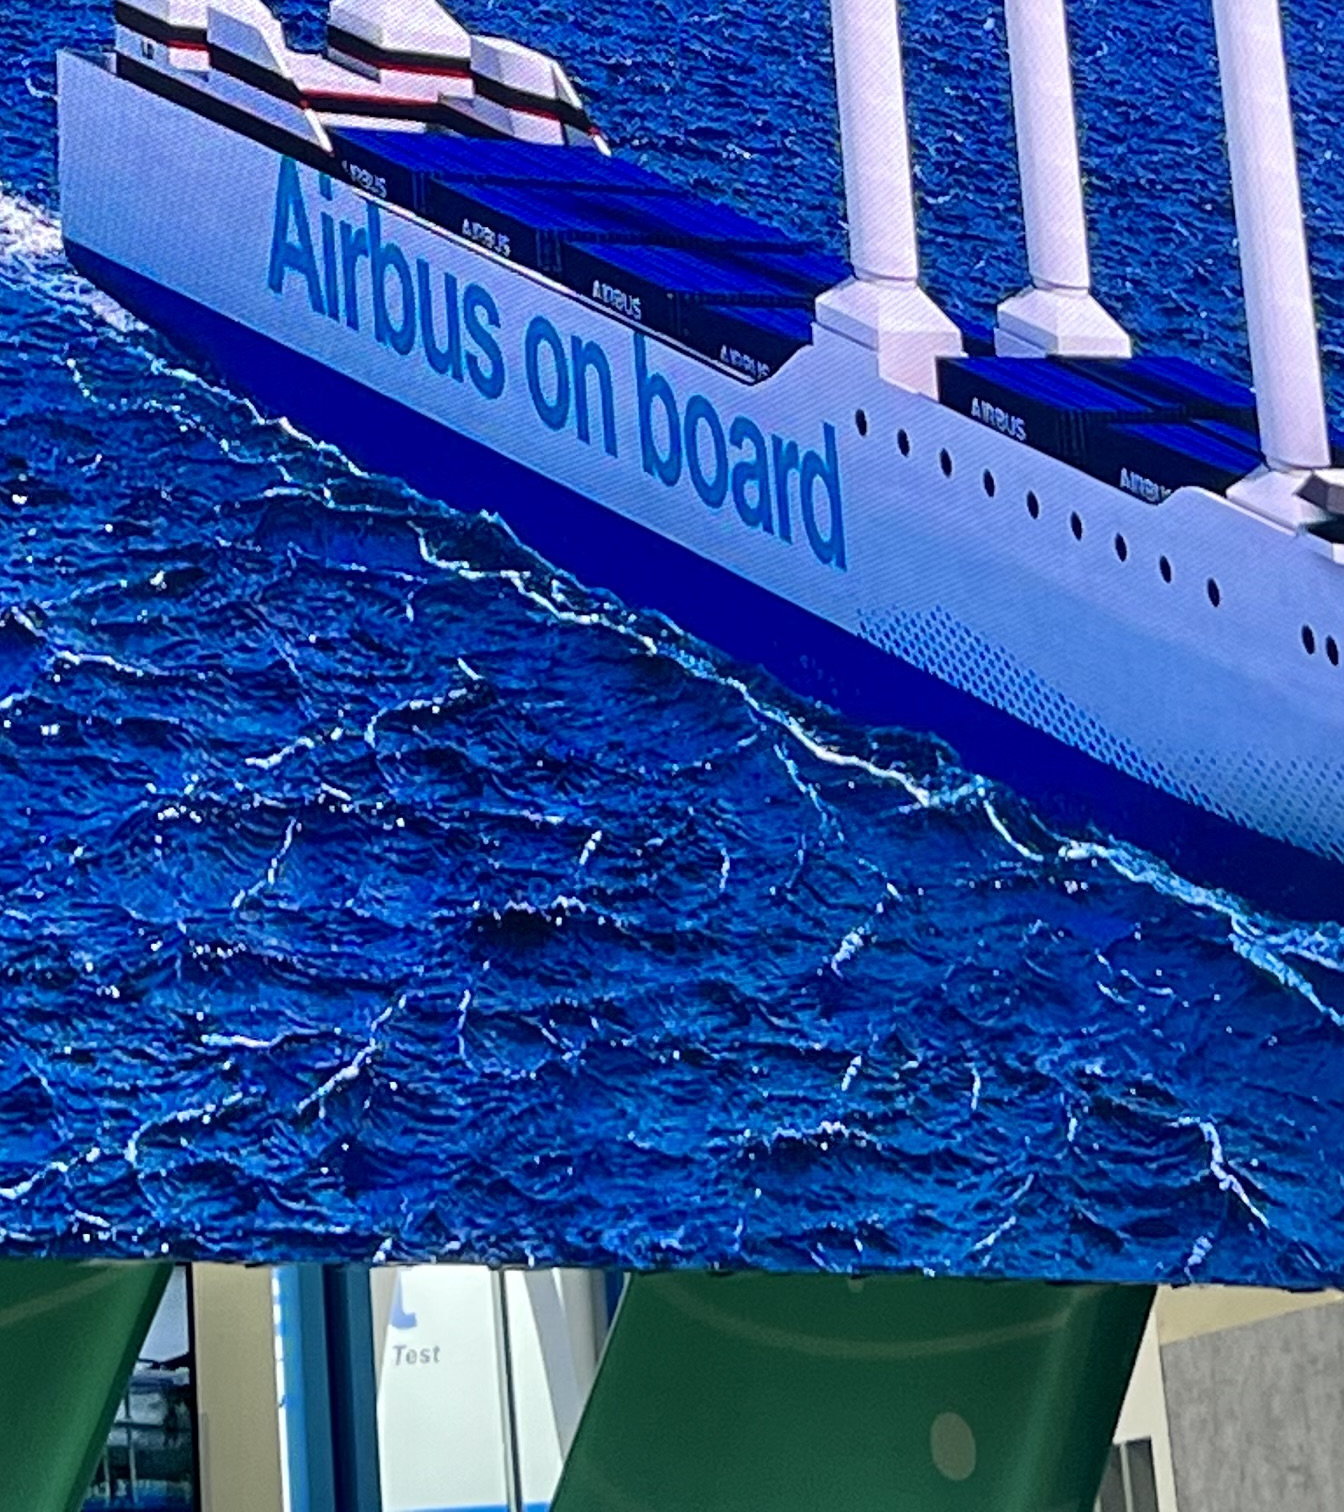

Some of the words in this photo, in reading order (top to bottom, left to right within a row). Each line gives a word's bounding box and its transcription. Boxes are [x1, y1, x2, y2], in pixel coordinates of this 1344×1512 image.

[592, 279, 642, 320] AIRBUS
[268, 155, 506, 400] Airbus
[524, 315, 620, 458] on
[633, 331, 847, 572] board
[971, 396, 1027, 441] AIRBUS
[392, 1344, 441, 1366] Test
